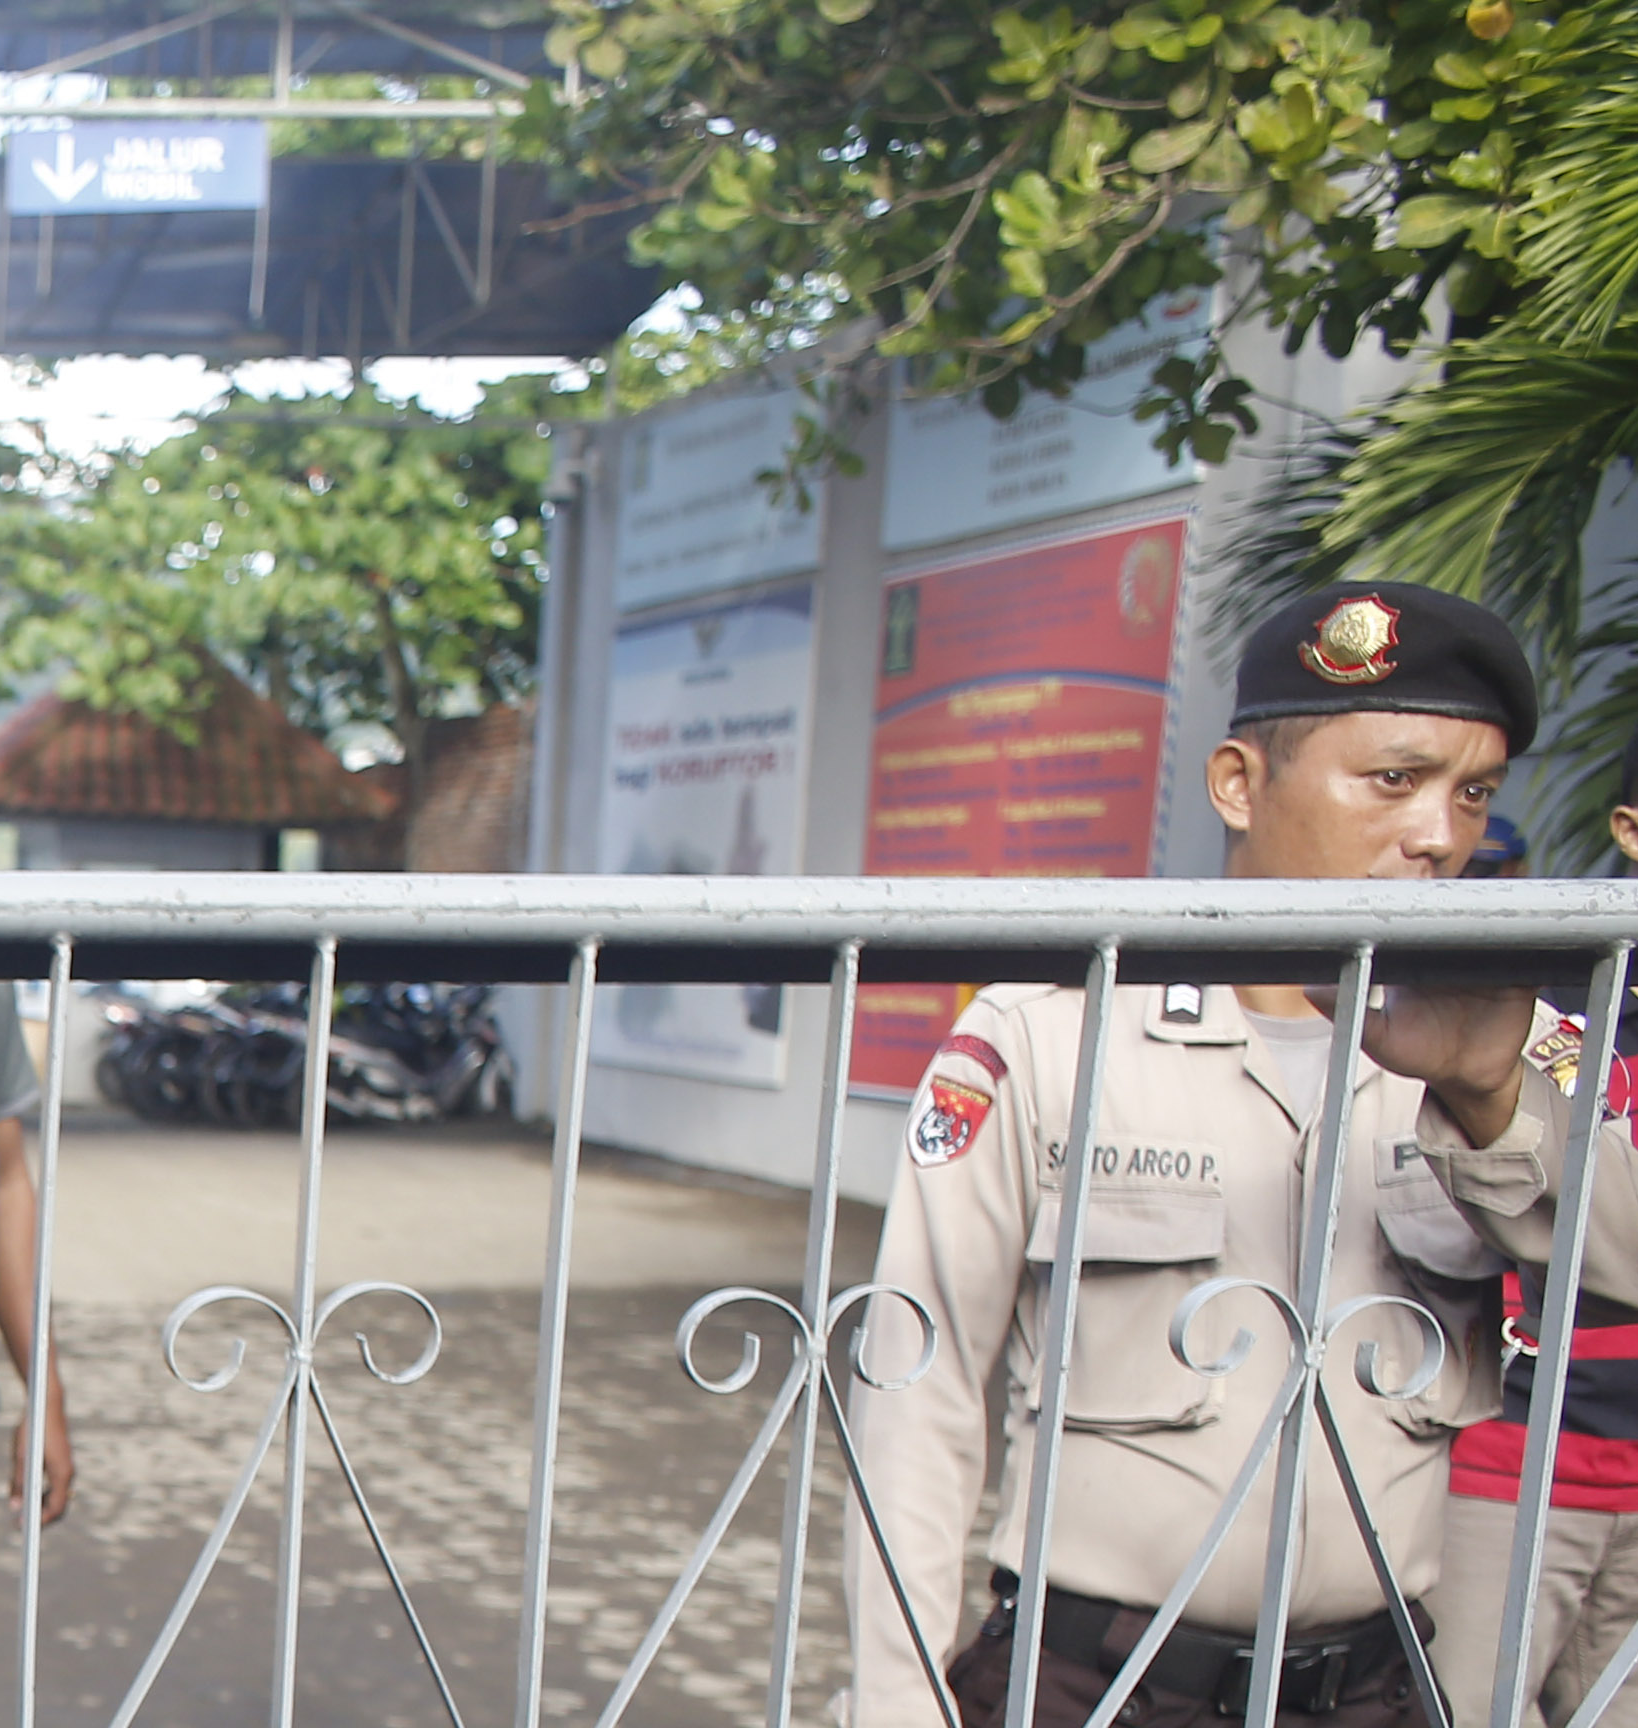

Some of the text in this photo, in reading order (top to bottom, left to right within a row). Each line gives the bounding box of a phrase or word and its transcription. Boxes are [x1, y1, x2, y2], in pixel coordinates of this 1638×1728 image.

[103, 136, 225, 173] JALUR
[102, 170, 203, 201] MOBIL
[1127, 1147, 1192, 1179] ARGO
[1200, 1154, 1221, 1183] P.
